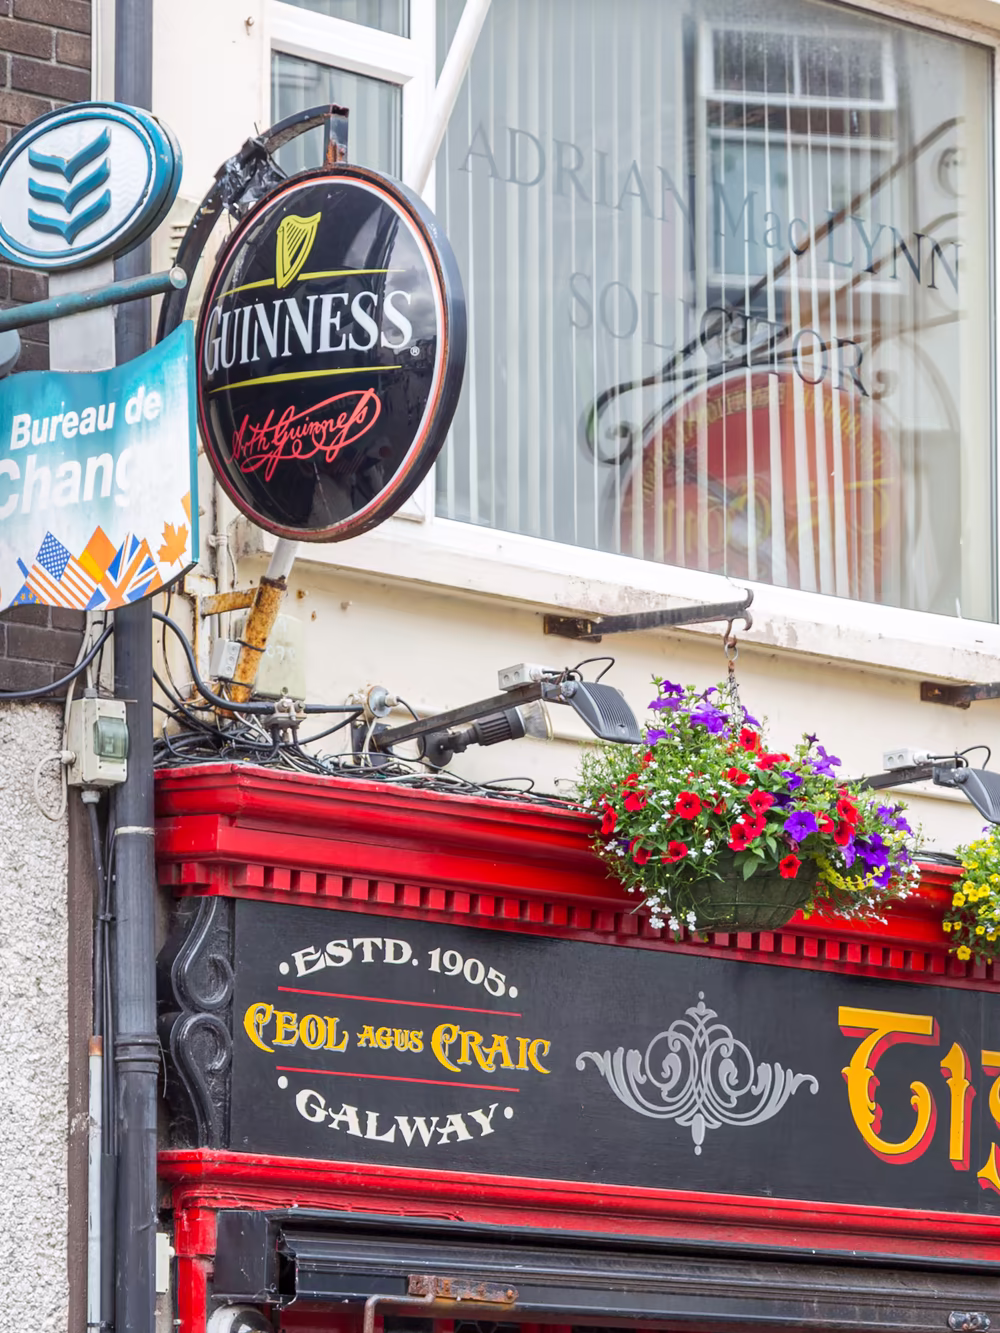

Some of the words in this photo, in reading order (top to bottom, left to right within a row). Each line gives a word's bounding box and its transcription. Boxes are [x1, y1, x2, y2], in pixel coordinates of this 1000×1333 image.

[204, 290, 413, 376] GUINNESS
[10, 402, 116, 450] Bureau
[124, 384, 162, 425] de
[0, 447, 133, 521] Chang
[291, 937, 419, 977] ESTD.
[357, 1025, 424, 1053] AGUS
[295, 1089, 499, 1147] GALWAY
